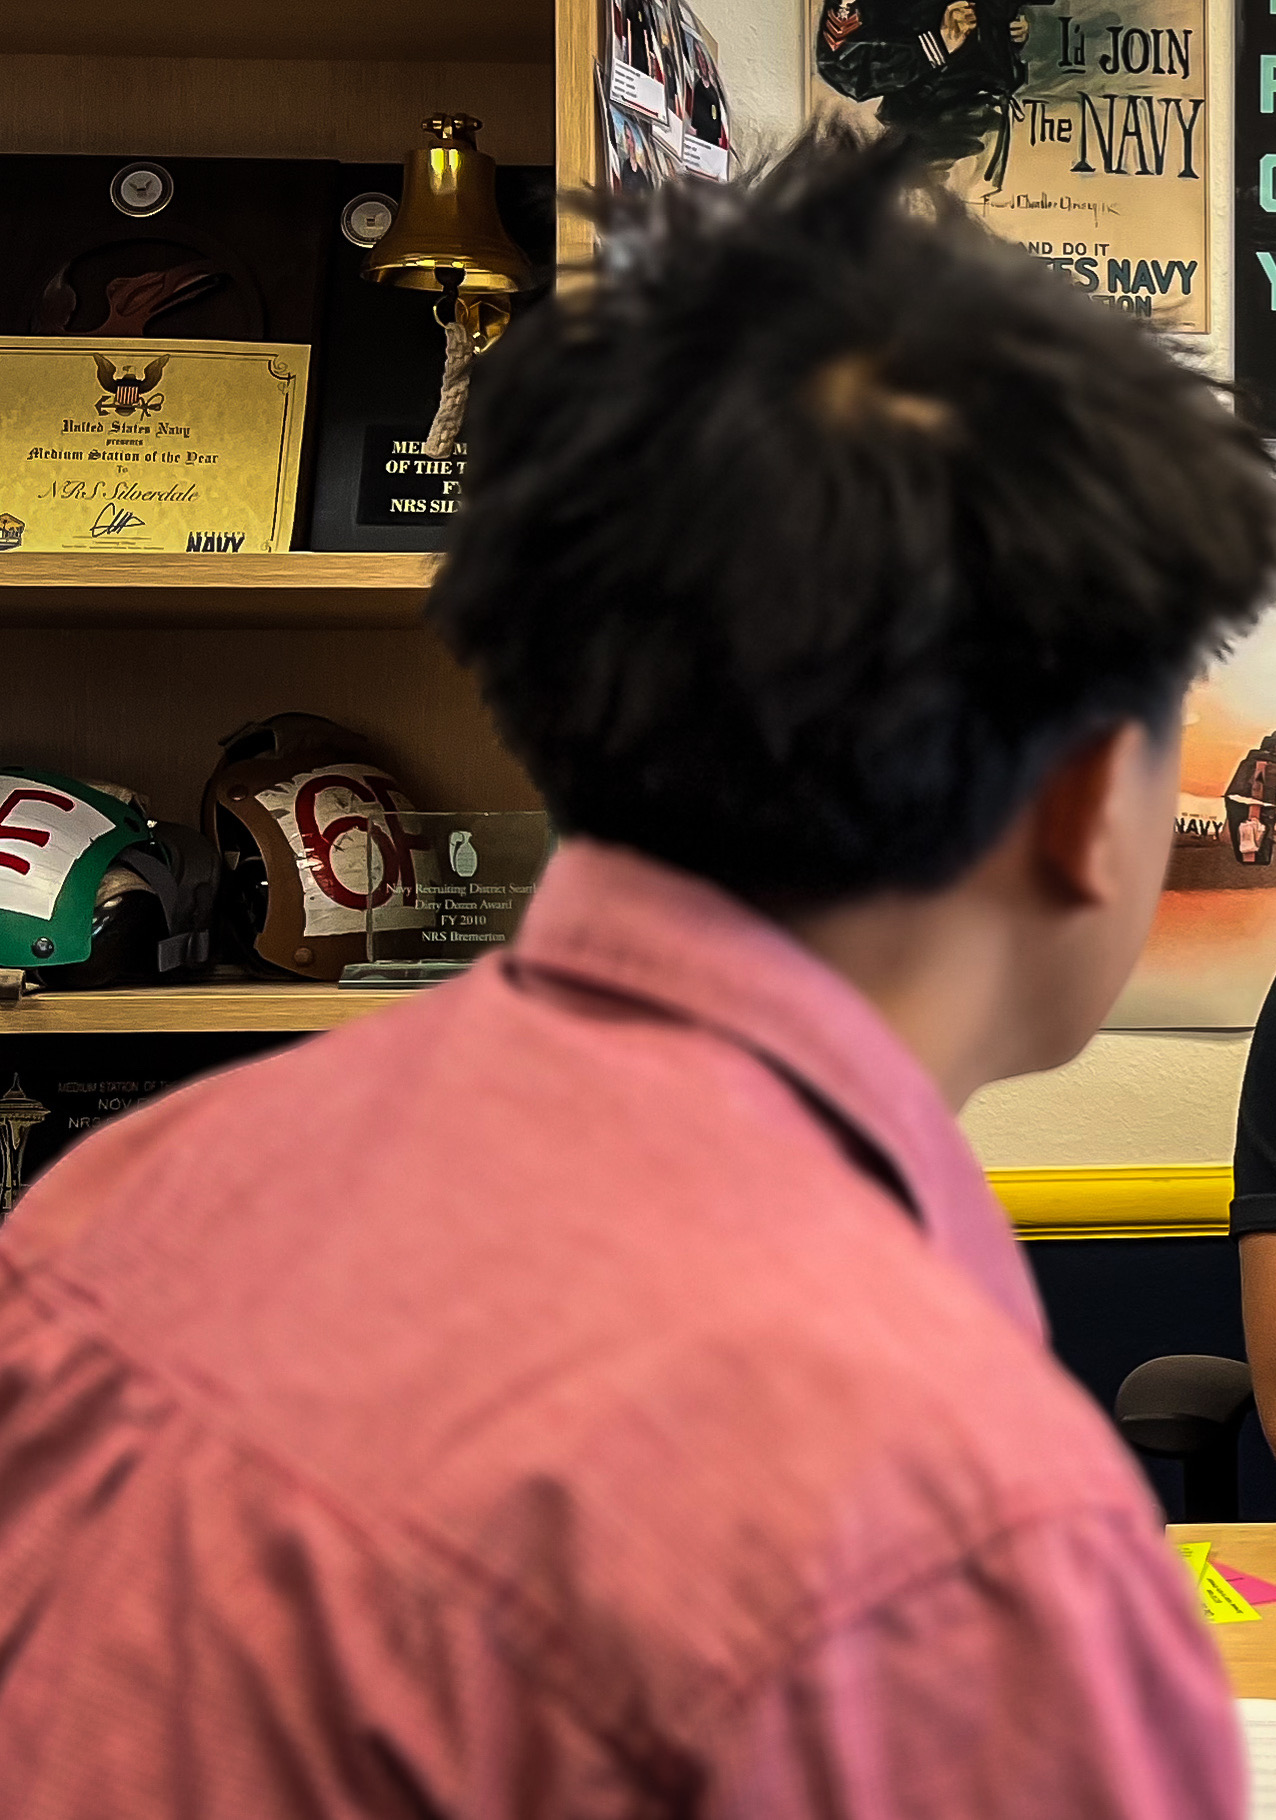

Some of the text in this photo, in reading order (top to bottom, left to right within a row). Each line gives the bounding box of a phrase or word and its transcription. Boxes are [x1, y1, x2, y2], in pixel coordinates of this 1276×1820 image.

[1099, 26, 1192, 79] JOIN
[1022, 91, 1205, 179] The NAVY
[1063, 242, 1087, 255] DO
[1094, 243, 1110, 256] IT
[1107, 258, 1198, 295] NAVY
[61, 419, 191, 439] United States Navy
[27, 447, 219, 466] Medium Station of the Year
[385, 460, 410, 474] OF
[414, 461, 452, 475] THE
[390, 499, 426, 513] NRS
[1174, 817, 1223, 839] NAVY
[386, 883, 412, 896] Navy
[416, 883, 466, 897] Recruiting
[469, 884, 506, 894] District
[415, 900, 512, 913] Dirty Dozen Award
[441, 915, 487, 926] FY 2010
[422, 931, 505, 942] NRS Bremerton
[100, 1081, 139, 1093] STATION
